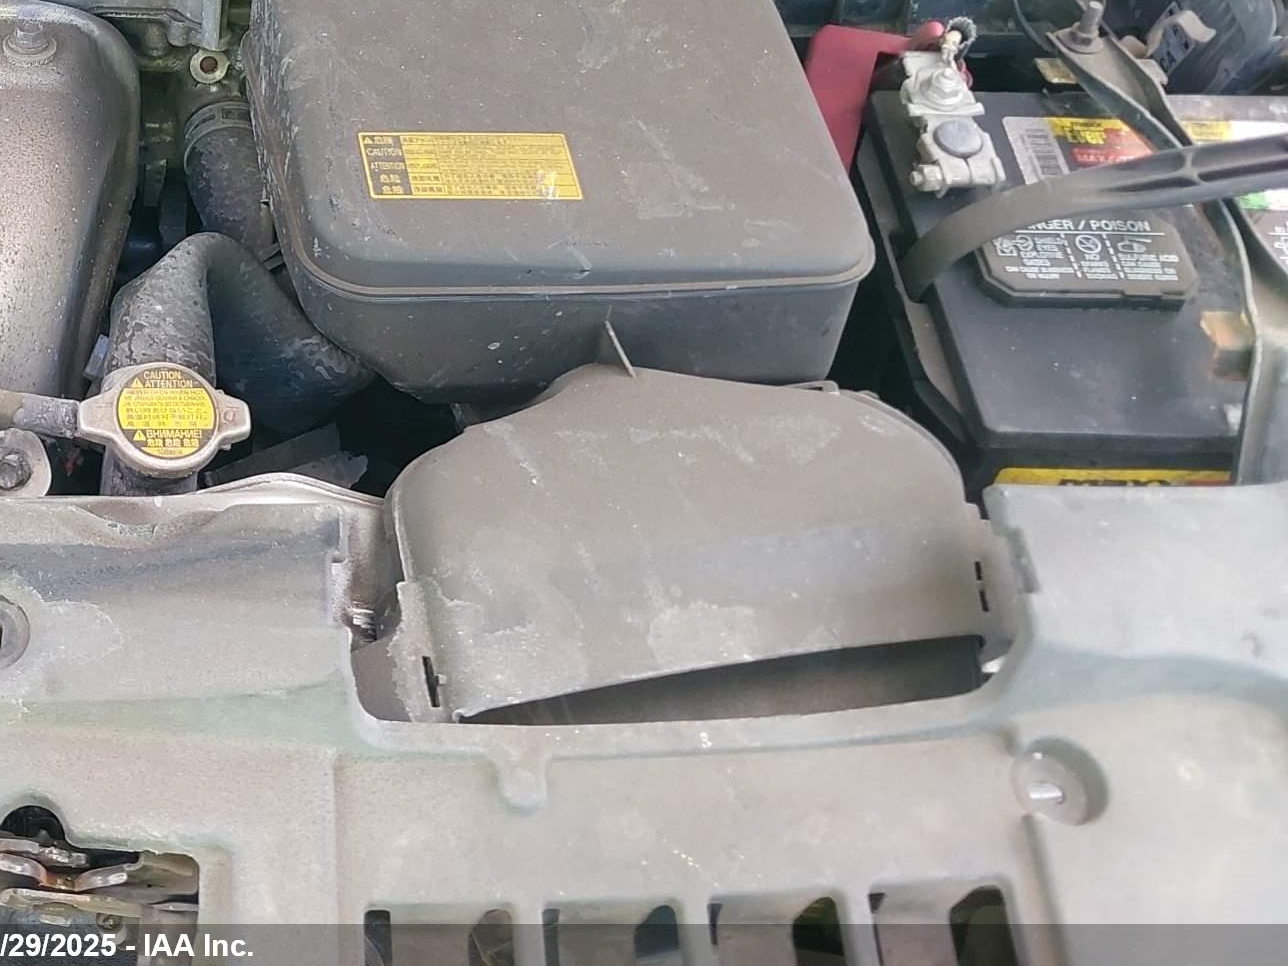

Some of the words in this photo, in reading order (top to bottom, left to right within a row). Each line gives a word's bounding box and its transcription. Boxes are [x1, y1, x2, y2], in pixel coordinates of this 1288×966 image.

[366, 147, 402, 156] CAUTION
[370, 161, 406, 170] ATTENTION
[1027, 219, 1074, 231] NGER
[1090, 219, 1151, 231] POISON
[143, 371, 181, 379] CAUTION
[144, 380, 193, 388] ATTENTION
[145, 429, 202, 438] ВНИМАНИЕ!
